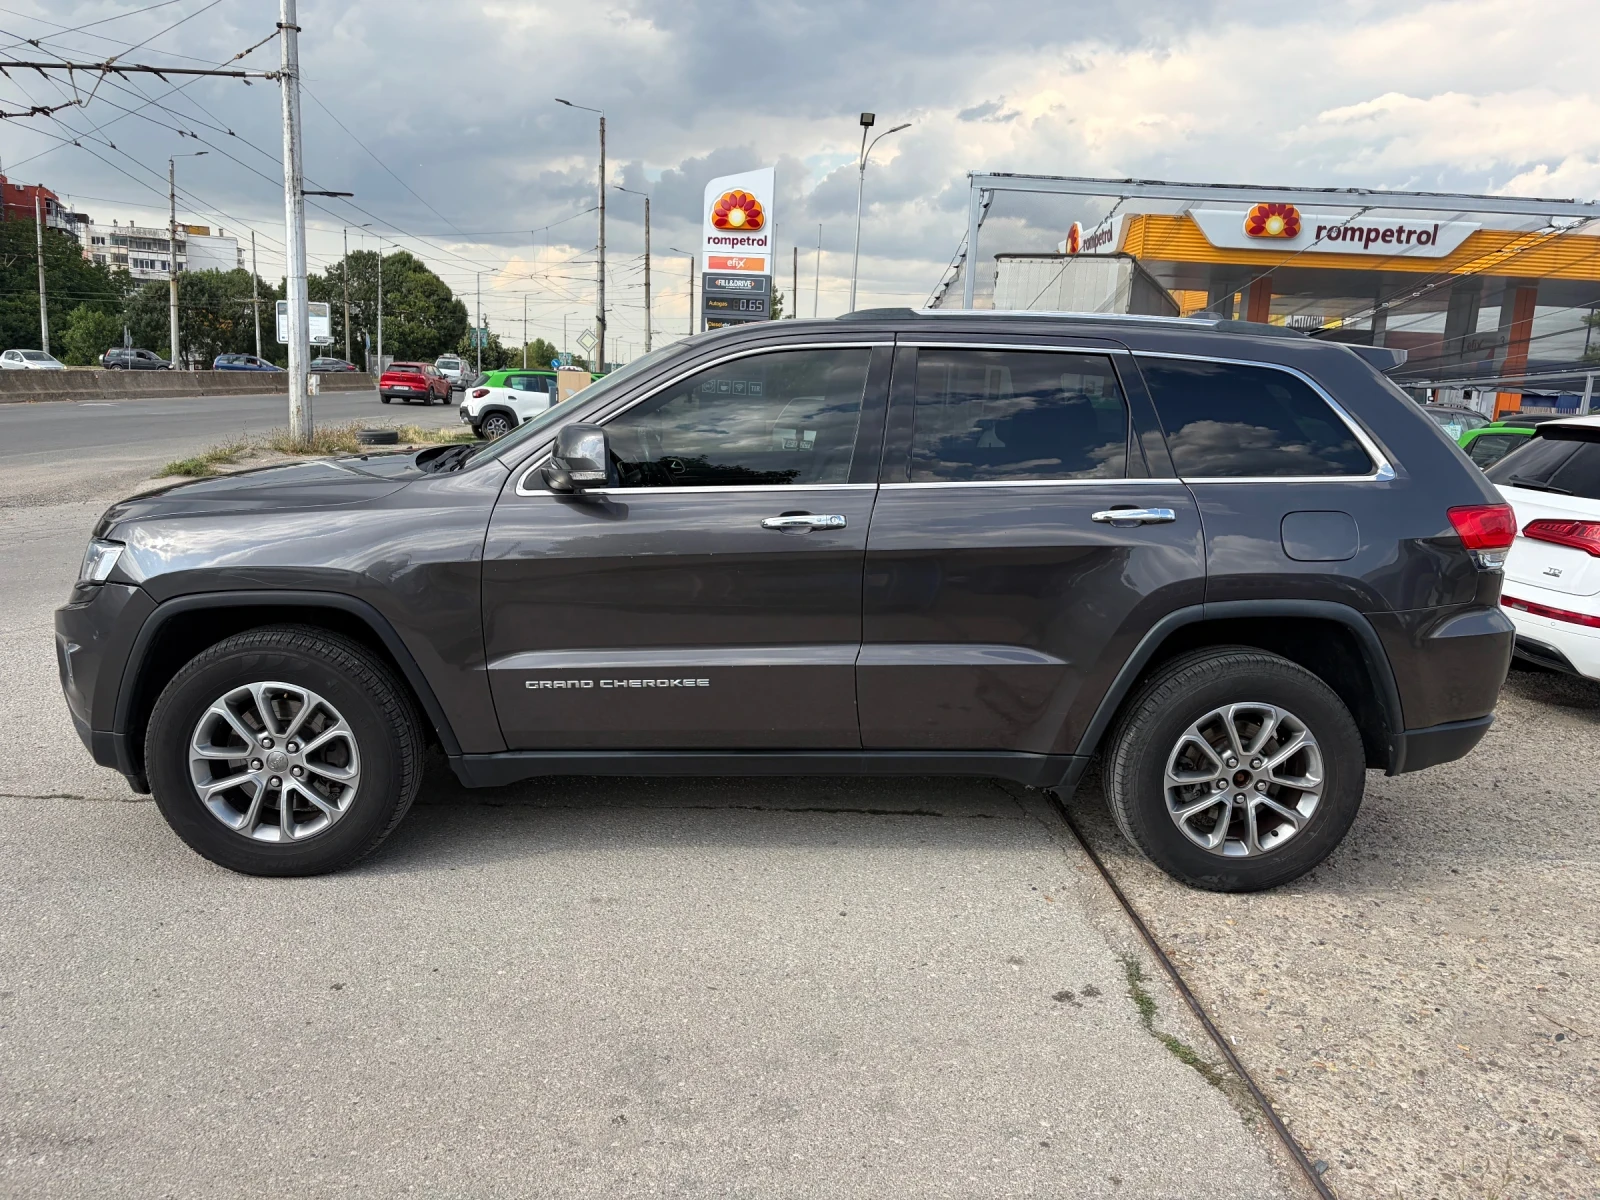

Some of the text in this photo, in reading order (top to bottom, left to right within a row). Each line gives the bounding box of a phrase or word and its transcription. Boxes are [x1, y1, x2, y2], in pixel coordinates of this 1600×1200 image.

[707, 235, 767, 248] rompetrol
[1315, 223, 1439, 250] rompetrol
[727, 258, 747, 269] efix
[718, 279, 752, 287] FILL&DRIVE
[740, 300, 763, 311] 0.65
[525, 678, 710, 689] GRAND CHEROKEE
